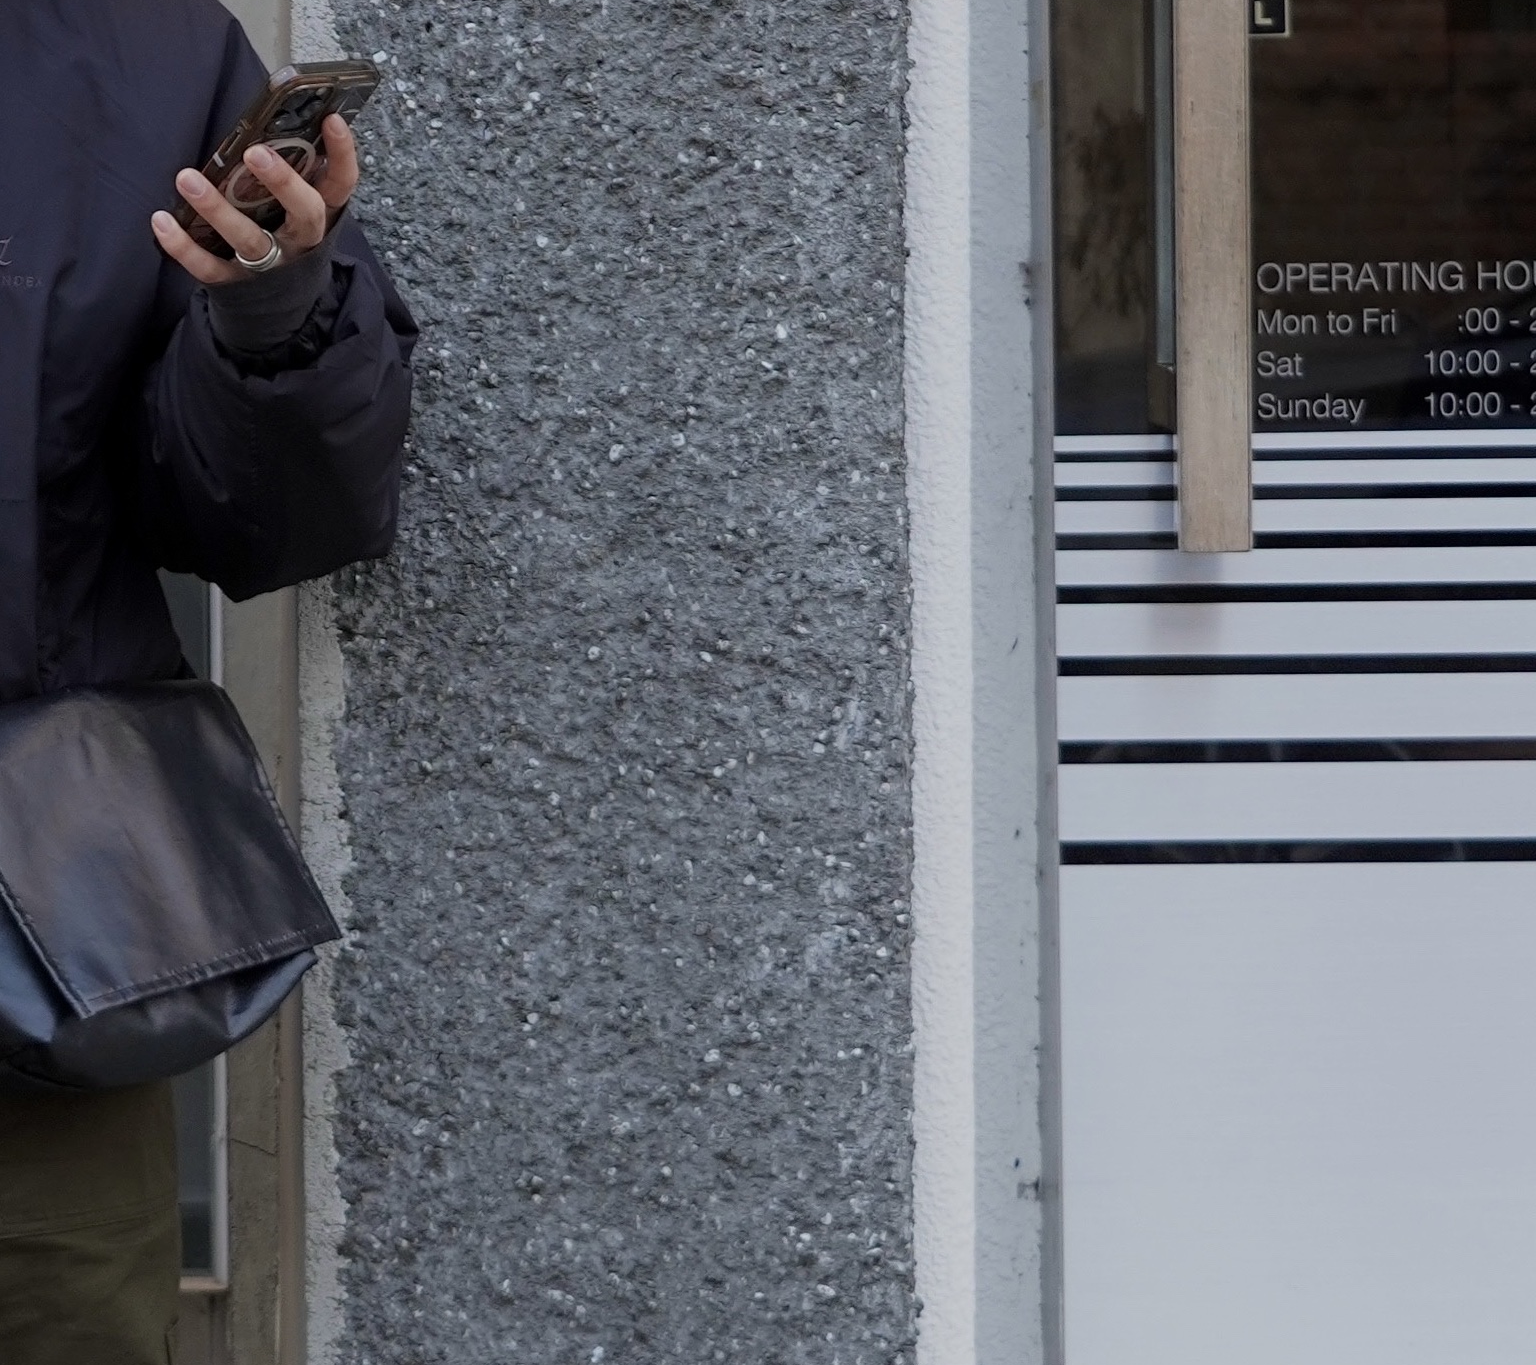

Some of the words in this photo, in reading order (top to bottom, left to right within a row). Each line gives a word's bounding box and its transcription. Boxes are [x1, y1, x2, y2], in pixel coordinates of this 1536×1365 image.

[1256, 260, 1464, 293] OPERATING
[1477, 259, 1536, 292] HO
[1257, 308, 1317, 335] Mon
[1326, 310, 1353, 335] to
[1363, 307, 1396, 334] Fri
[1256, 350, 1304, 377] Sat
[1424, 349, 1501, 376] 10:00
[1257, 392, 1364, 424] Sunday
[1424, 391, 1501, 417] 10:00
